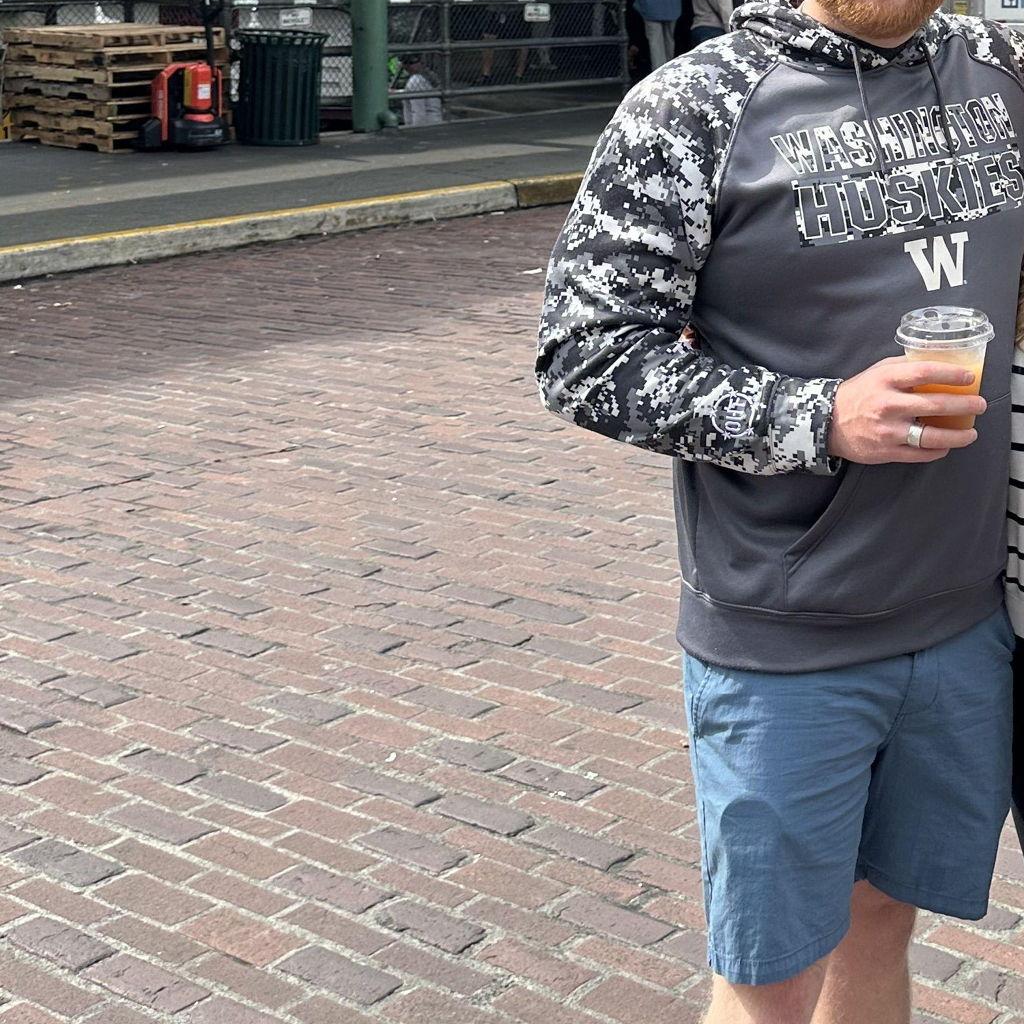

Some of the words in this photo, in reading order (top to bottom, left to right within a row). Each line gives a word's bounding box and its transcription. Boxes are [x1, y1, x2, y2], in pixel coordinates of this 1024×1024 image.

[770, 93, 1017, 175] WASHINGTON
[797, 150, 1024, 240] HUSKIES
[904, 231, 969, 291] W
